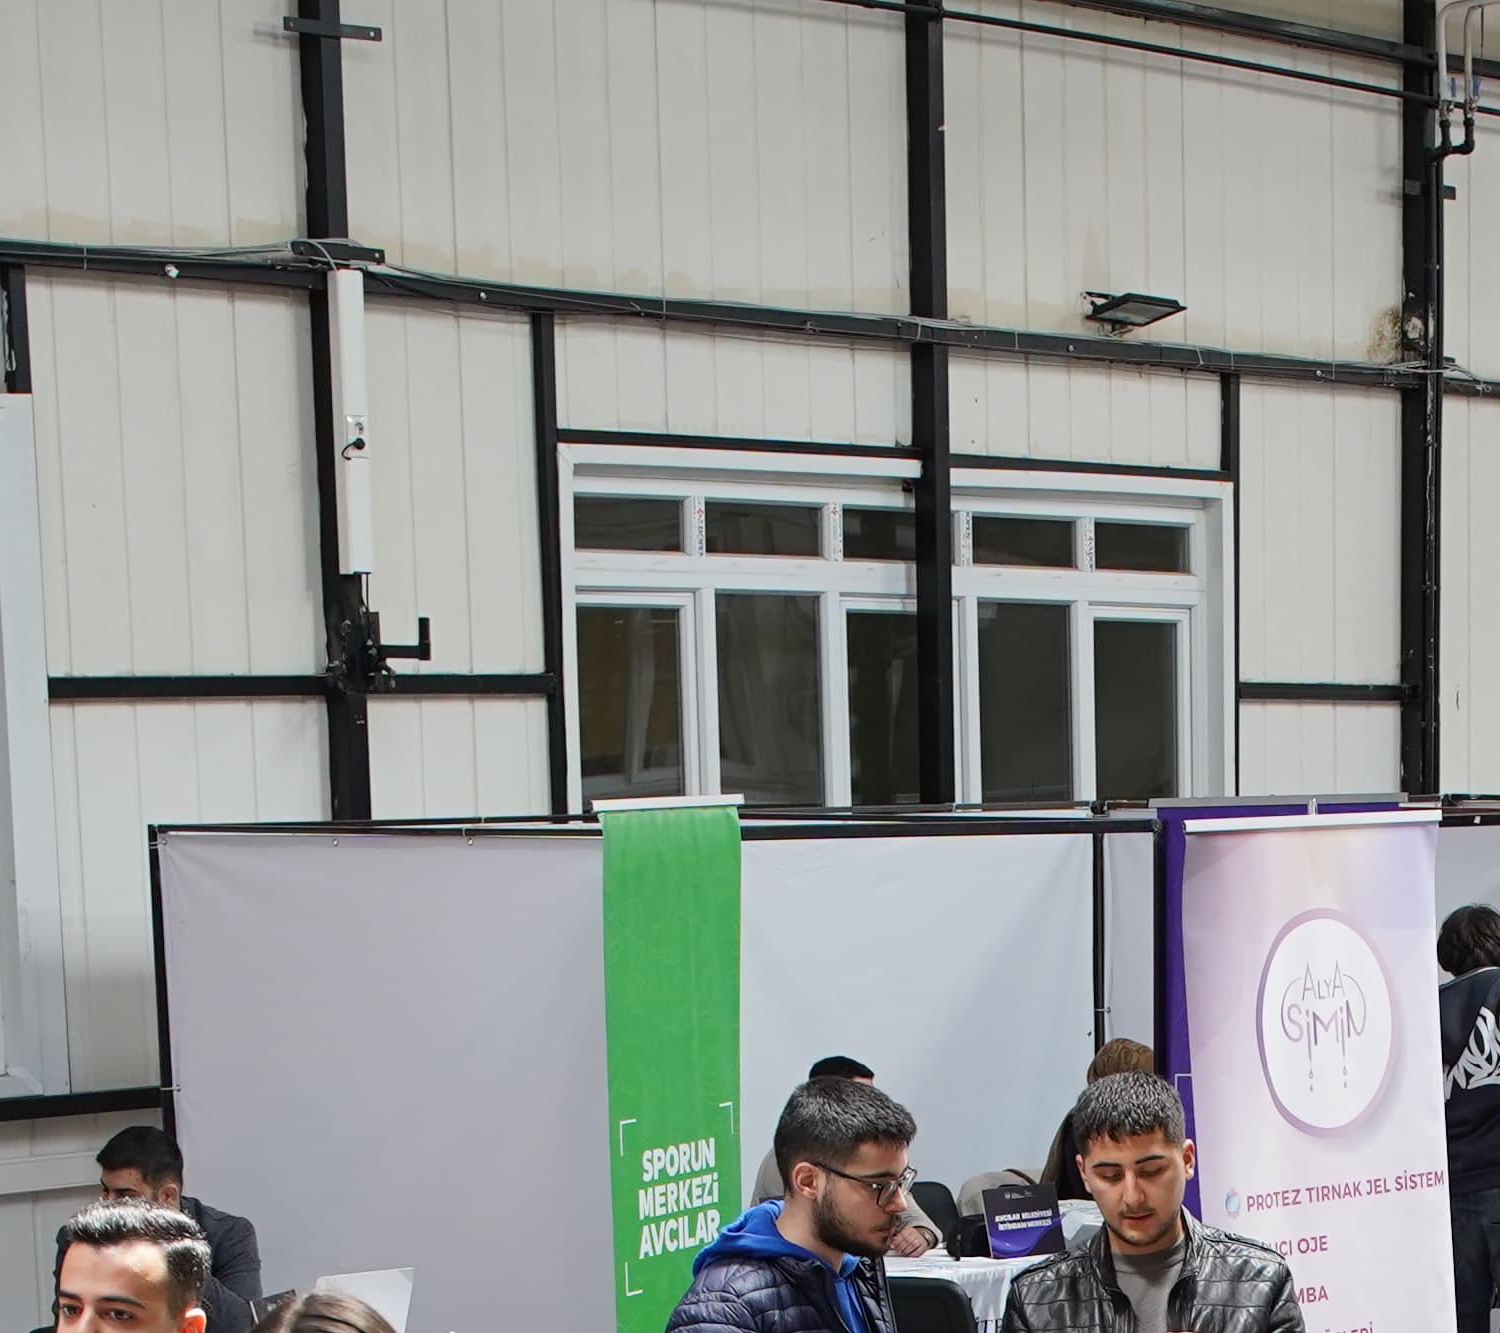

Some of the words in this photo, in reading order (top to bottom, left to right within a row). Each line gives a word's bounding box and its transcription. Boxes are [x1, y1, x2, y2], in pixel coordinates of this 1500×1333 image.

[642, 1137, 716, 1182] SPORUN
[1246, 1188, 1302, 1213] PROTEZ
[1305, 1181, 1363, 1204] TIRNAK
[1365, 1175, 1391, 1197] JEL
[1394, 1169, 1445, 1193] SİSTEM
[638, 1208, 721, 1260] AVCILAR
[1297, 1235, 1329, 1255] OJE
